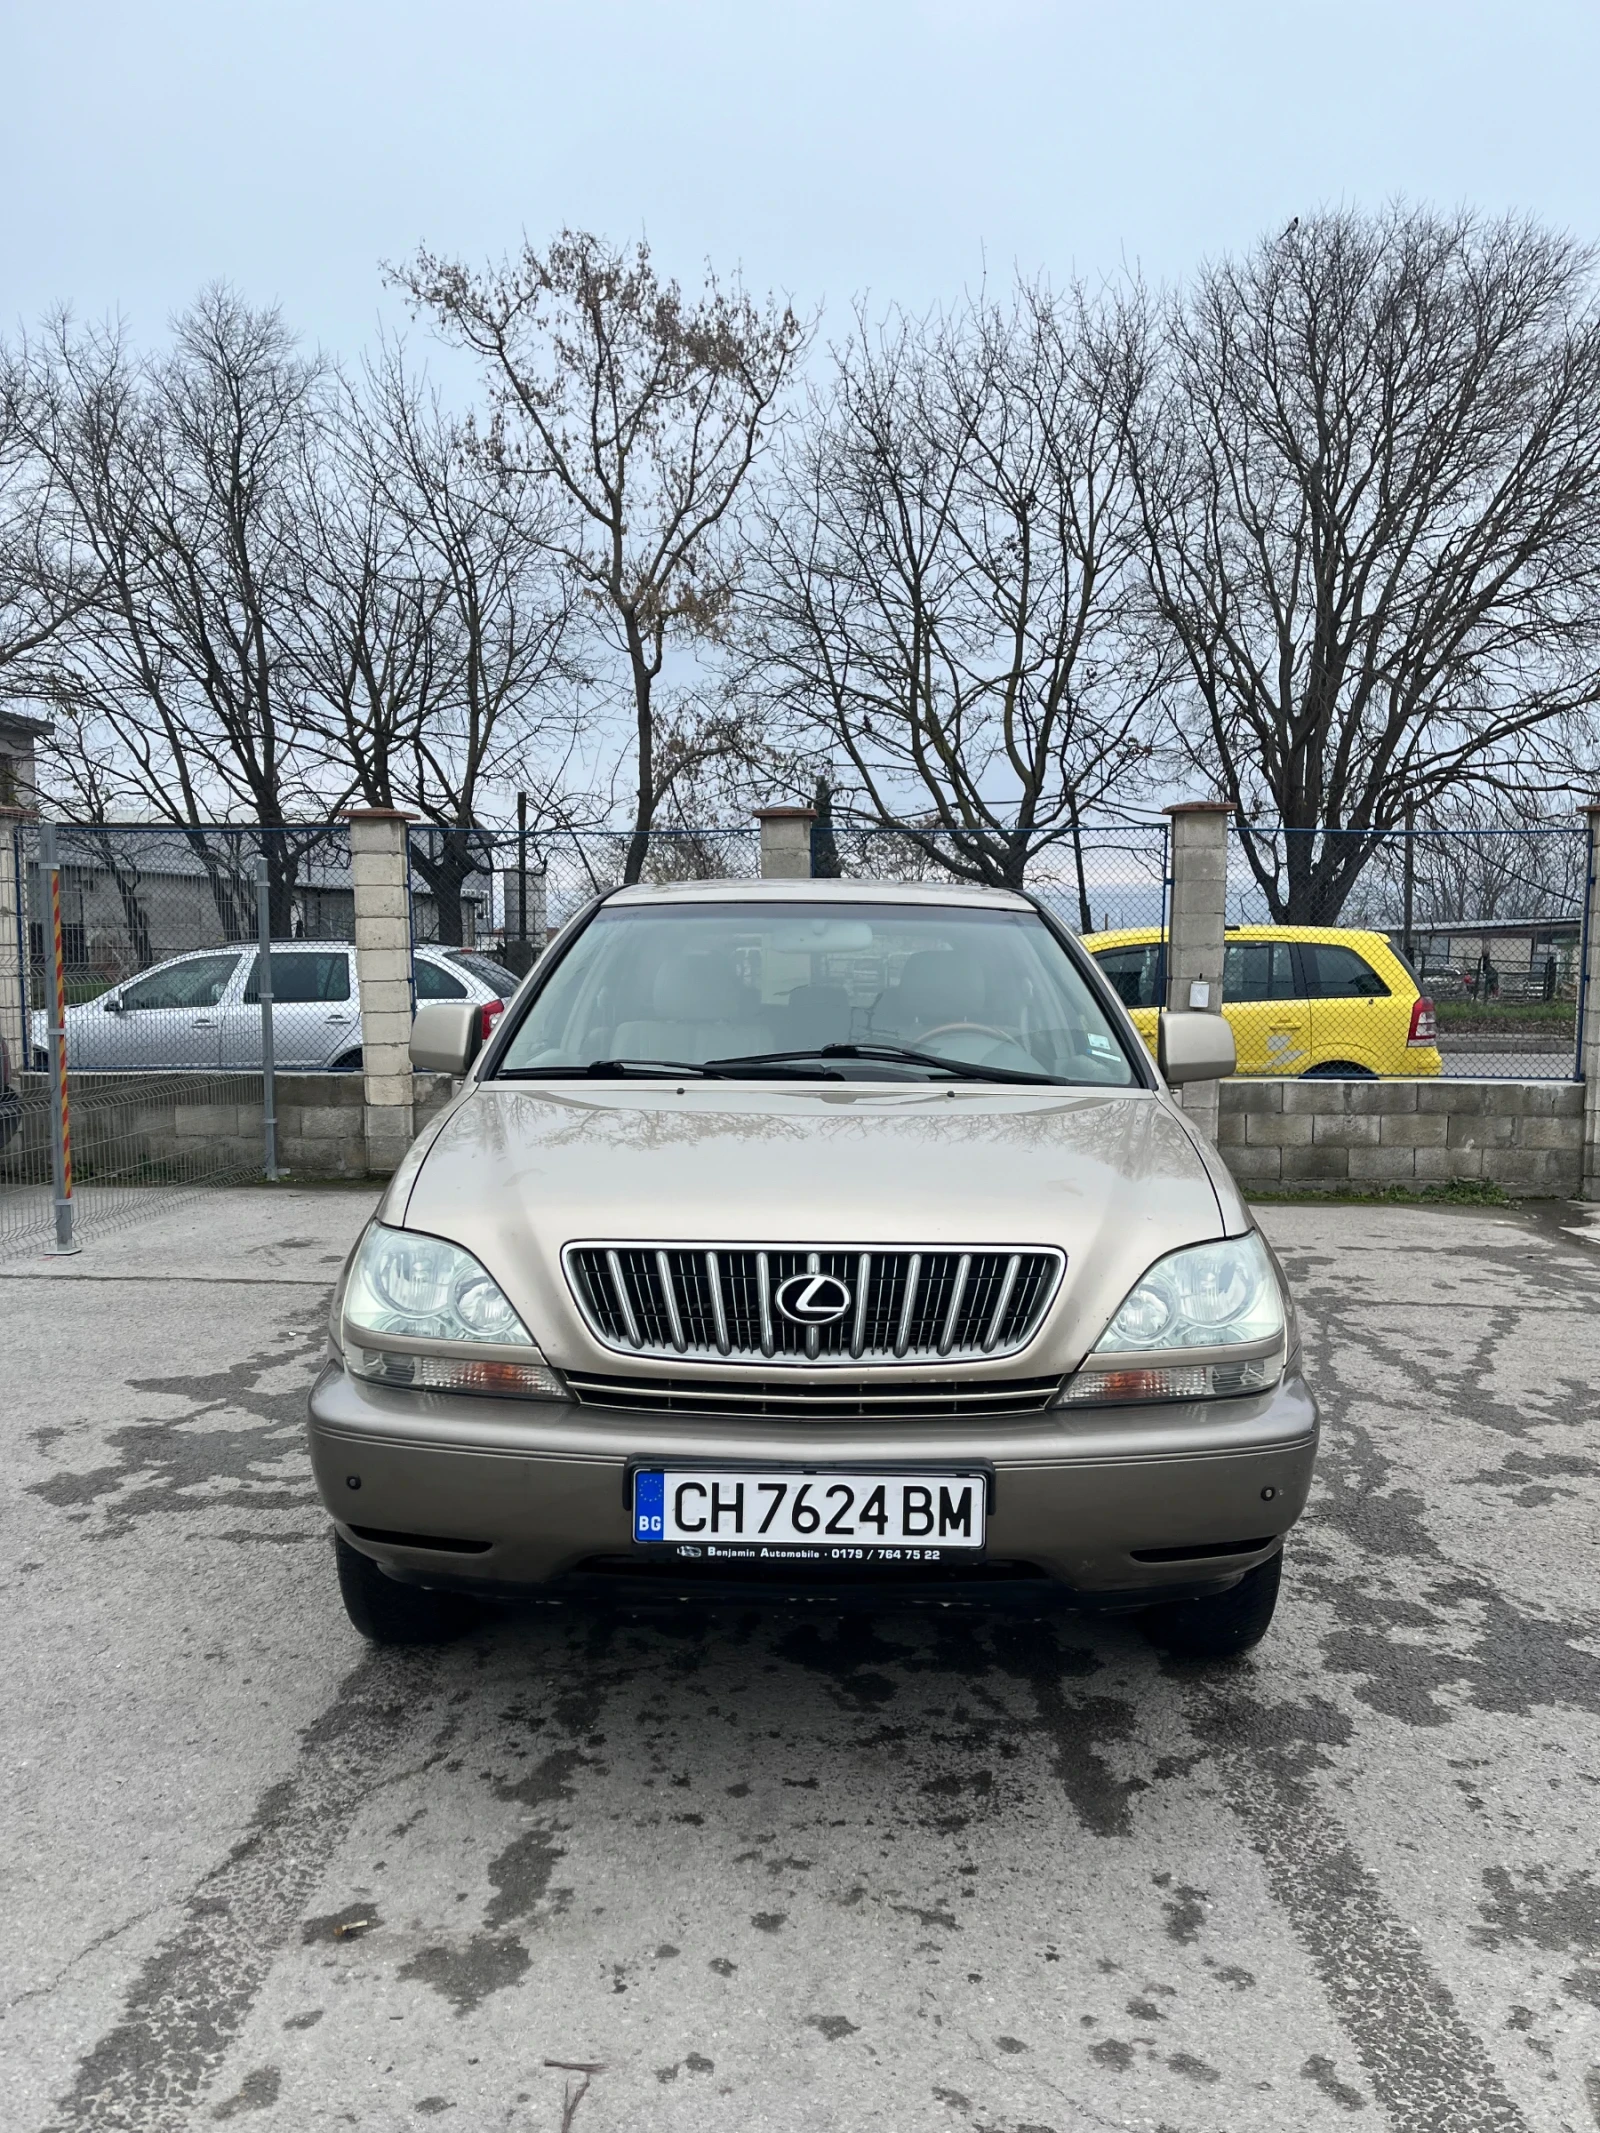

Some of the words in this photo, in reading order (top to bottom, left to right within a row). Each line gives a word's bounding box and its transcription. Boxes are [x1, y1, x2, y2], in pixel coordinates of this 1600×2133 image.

[674, 1482, 745, 1533] CH
[757, 1483, 889, 1536] 7624
[902, 1486, 973, 1538] BM
[638, 1515, 662, 1532] BG
[707, 1546, 756, 1558] Benjamin
[760, 1547, 820, 1559] Automobile
[831, 1548, 863, 1559] 0179
[877, 1549, 901, 1560] 764
[905, 1549, 921, 1560] 75
[924, 1550, 941, 1560] 22
